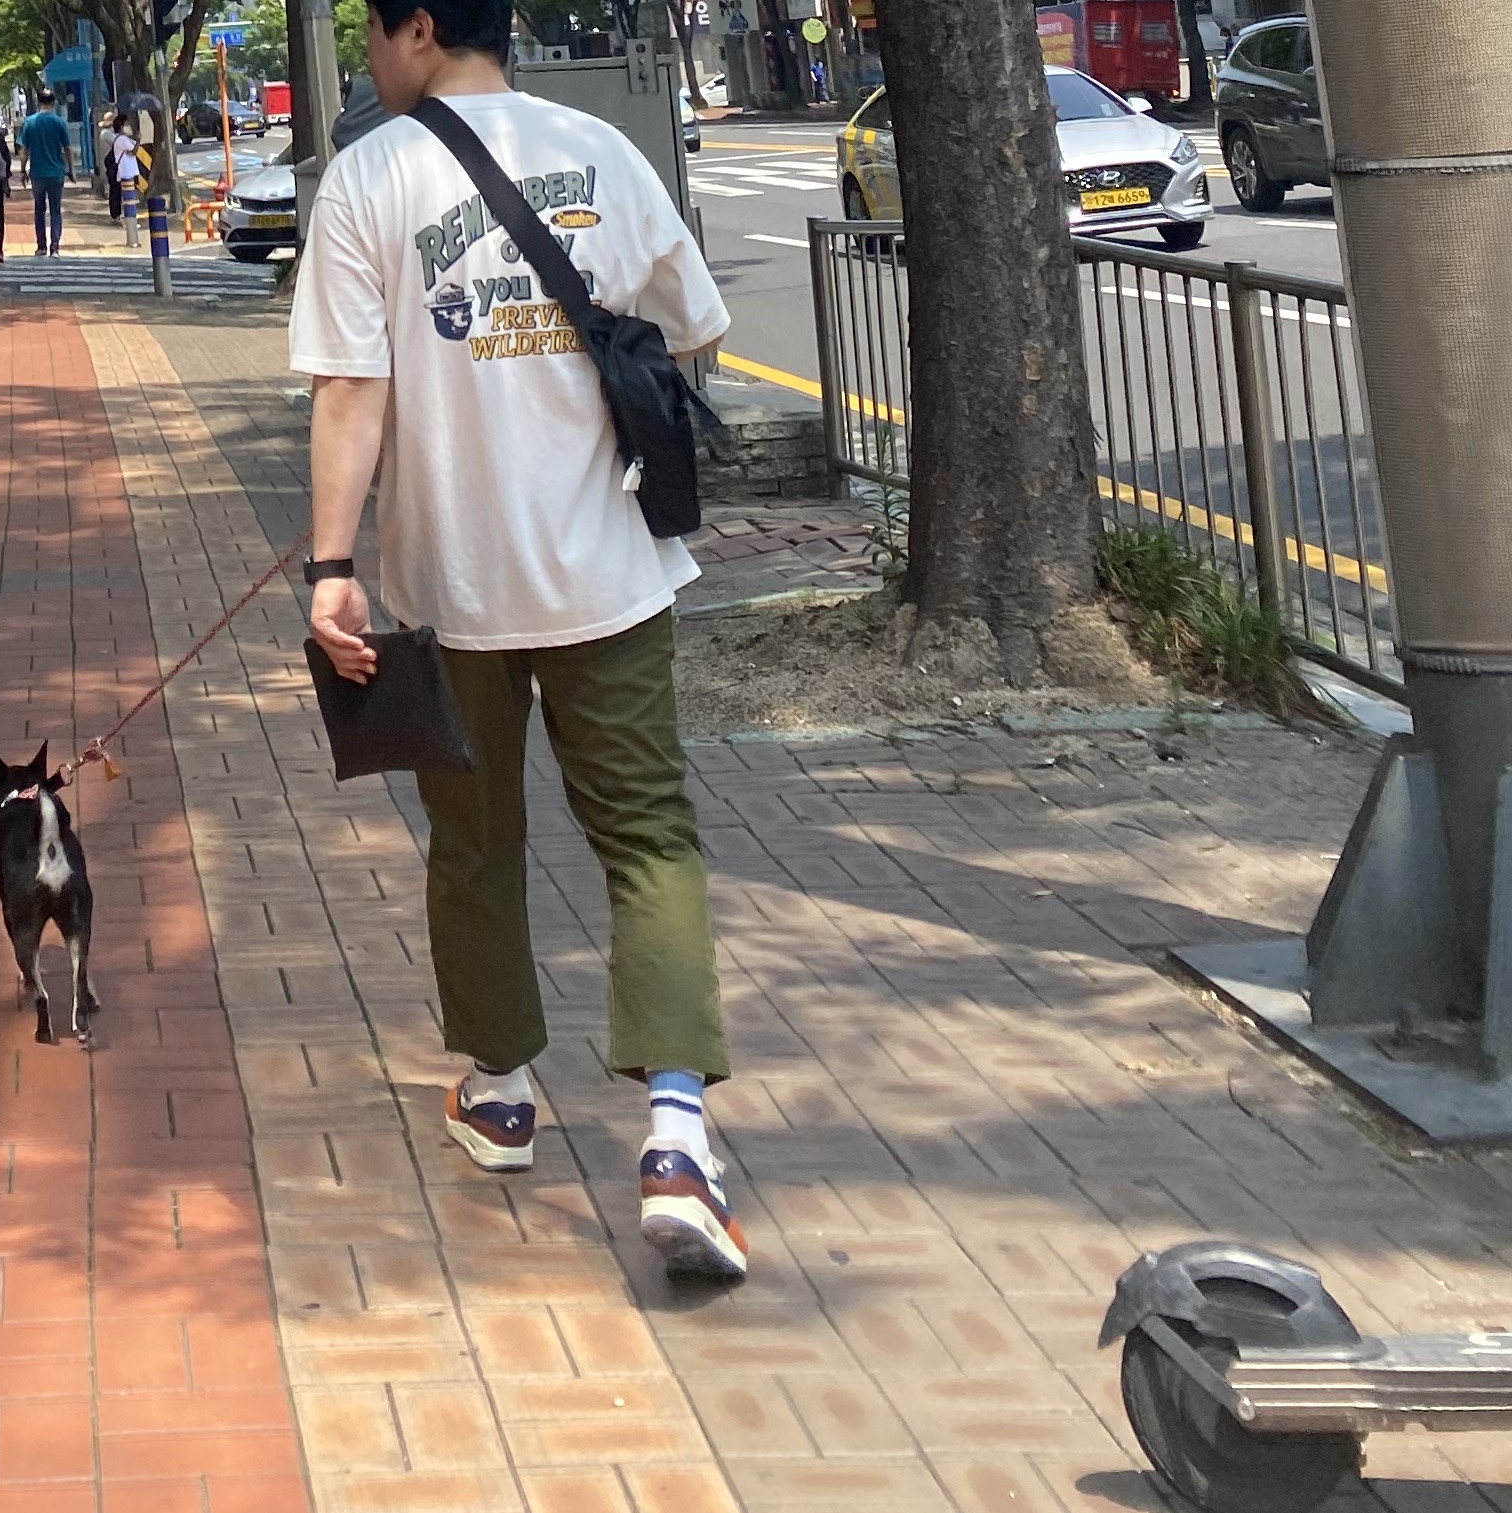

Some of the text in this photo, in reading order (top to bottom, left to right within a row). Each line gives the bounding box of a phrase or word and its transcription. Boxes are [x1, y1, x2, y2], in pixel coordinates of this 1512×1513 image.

[415, 165, 596, 292] REMBER!
[491, 300, 602, 332] PREVE
[469, 329, 588, 361] WILDFIRE
